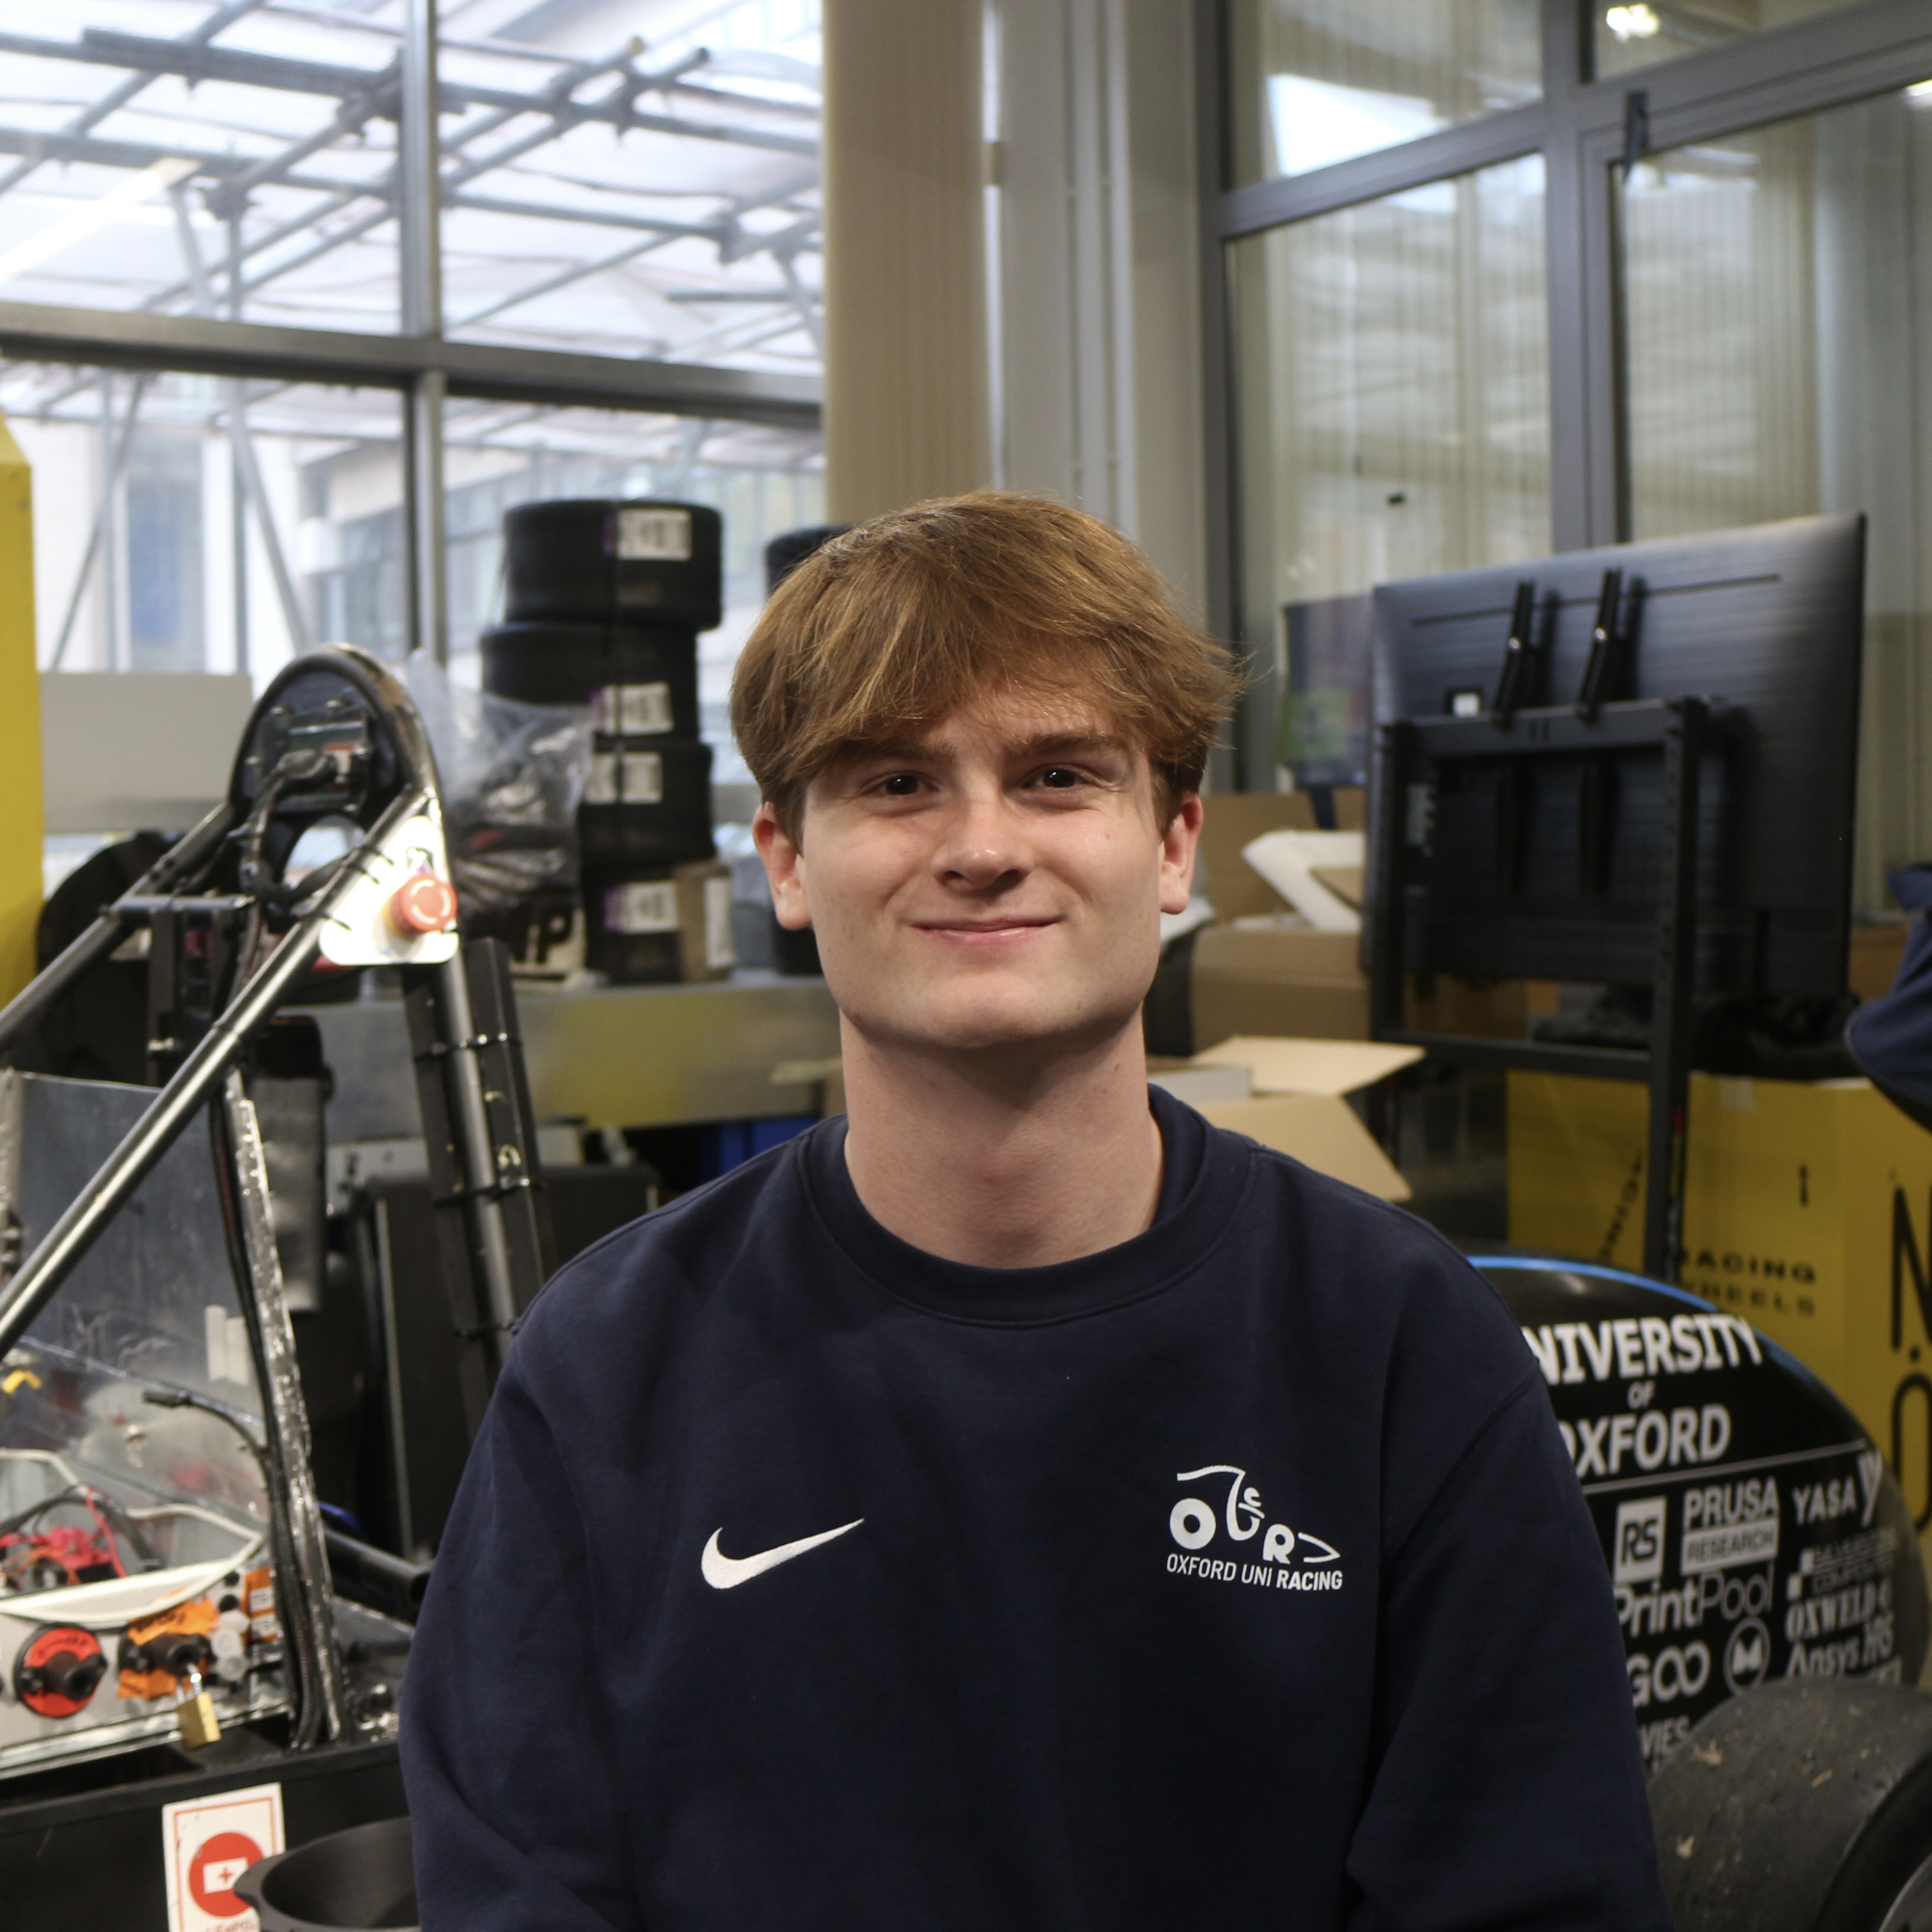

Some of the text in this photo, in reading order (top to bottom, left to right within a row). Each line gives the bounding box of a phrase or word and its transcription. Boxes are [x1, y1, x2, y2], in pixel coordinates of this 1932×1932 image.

[1682, 1248, 1816, 1285] ACING
[1521, 1313, 1763, 1385] NIVERSITY
[1627, 1380, 1655, 1409] OF
[1684, 1476, 1779, 1531] PRUSA
[1792, 1476, 1857, 1526] YASA
[1622, 1517, 1658, 1565] RS
[1688, 1528, 1775, 1564] RESEARCH
[1167, 1554, 1343, 1590] OXFORD UNI RACING
[1614, 1561, 1774, 1637] PrintPool
